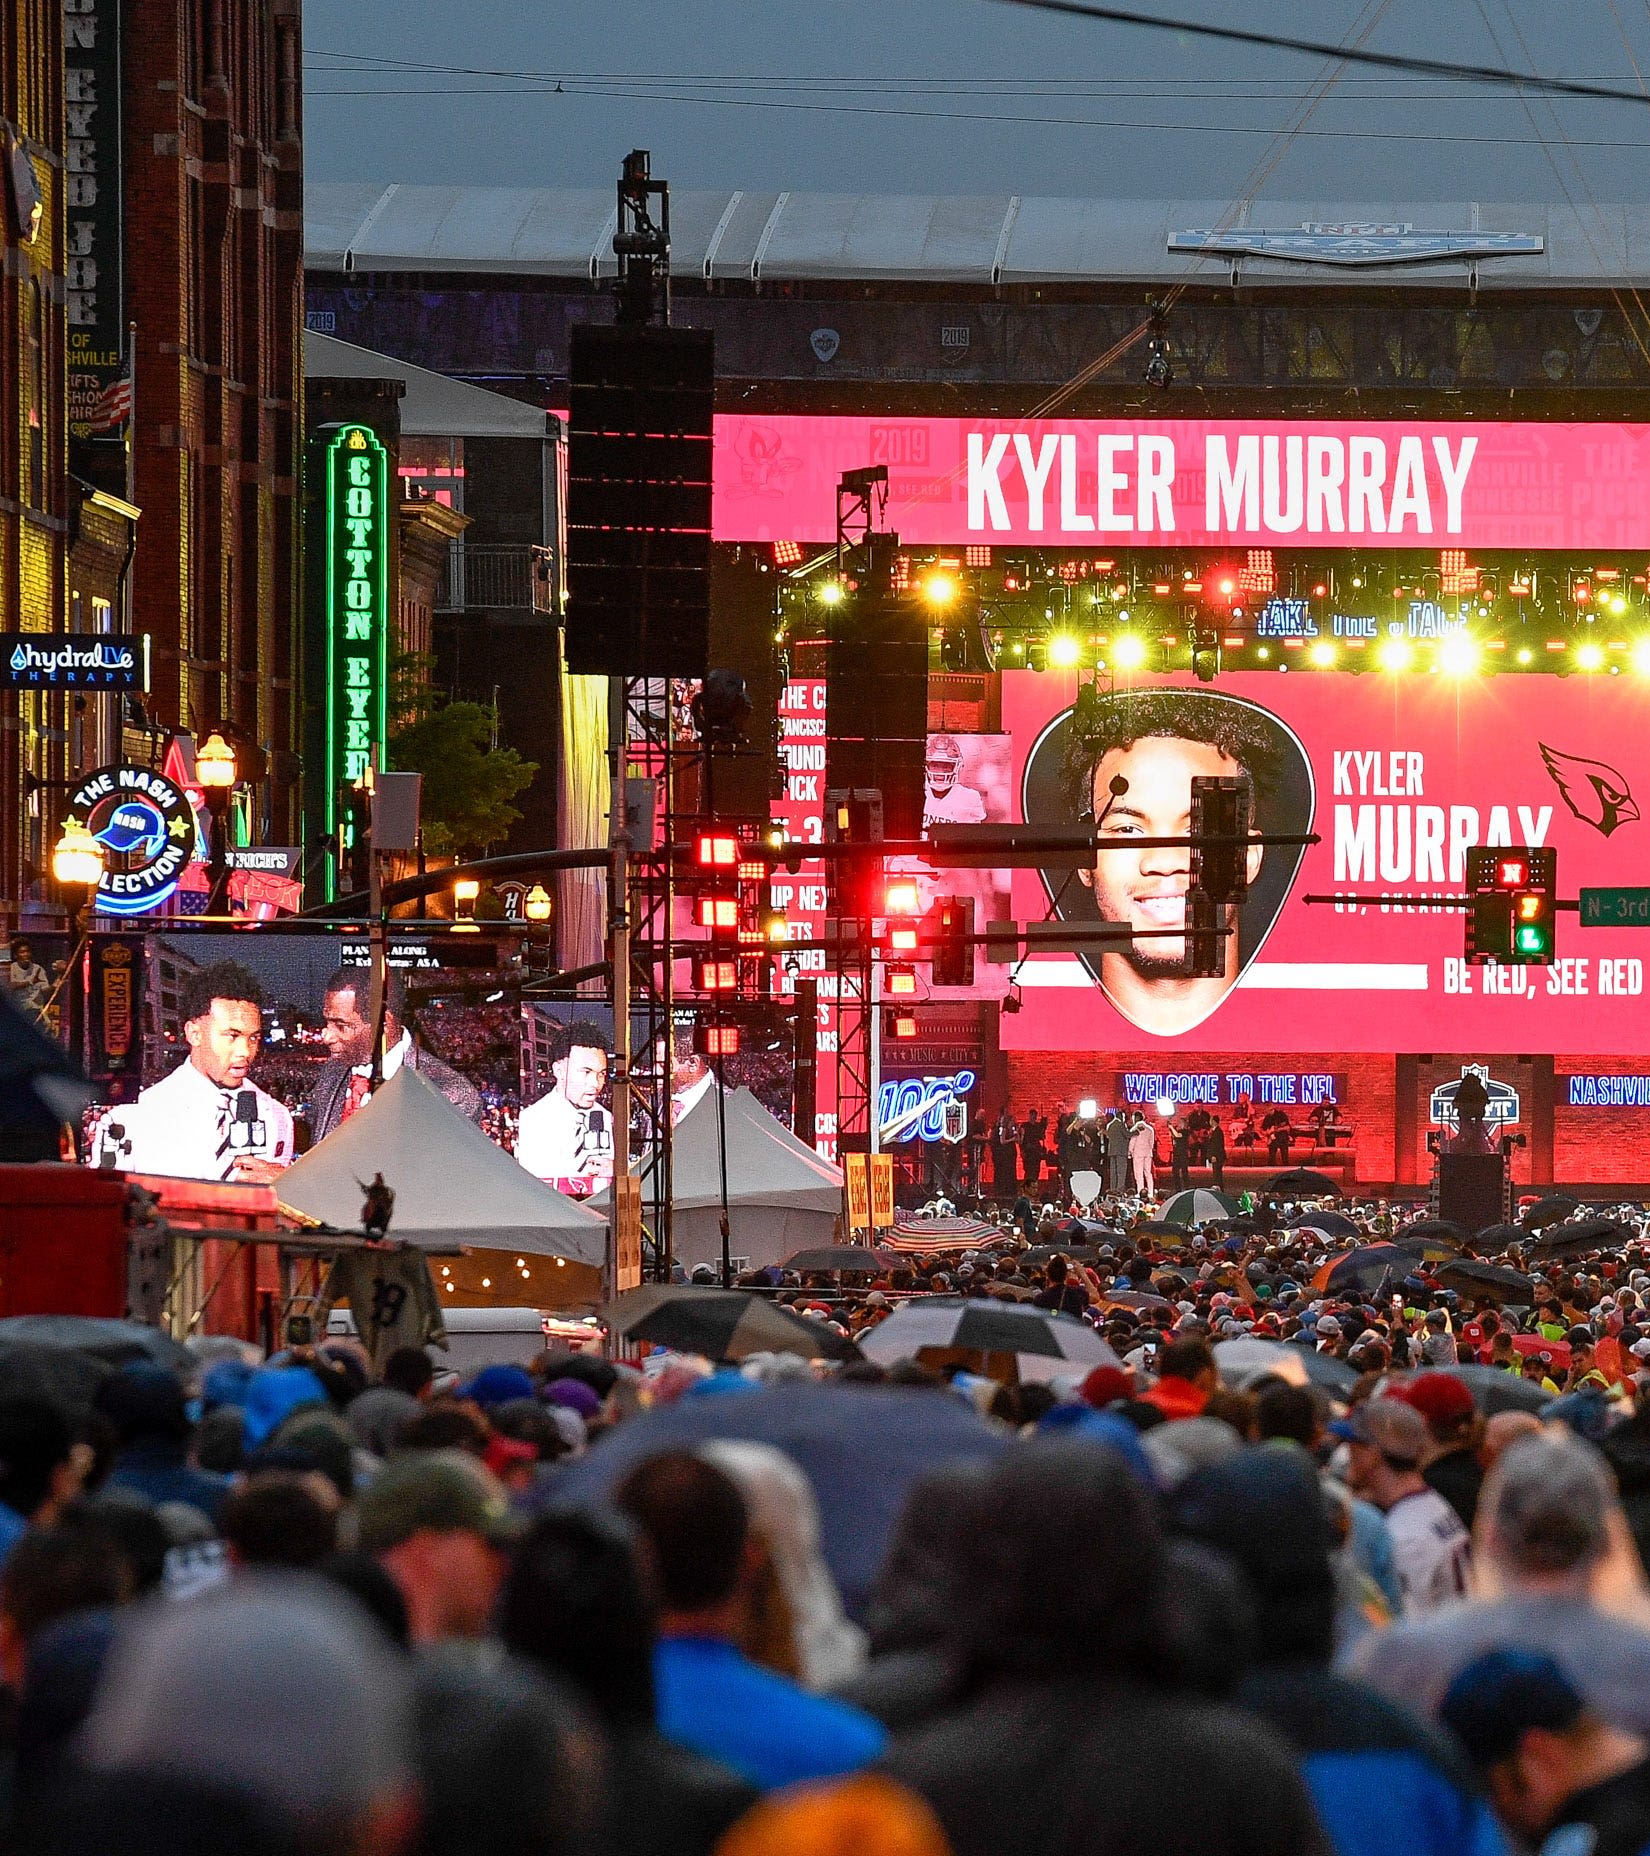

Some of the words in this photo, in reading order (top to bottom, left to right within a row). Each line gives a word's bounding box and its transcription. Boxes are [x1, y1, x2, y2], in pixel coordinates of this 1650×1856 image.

[72, 333, 91, 348] OF
[943, 328, 968, 345] 2019
[872, 428, 927, 463] 2019
[967, 433, 1176, 532] KYLER
[1205, 434, 1479, 534] MURRAY
[344, 456, 373, 640] COTTON
[10, 671, 134, 682] THERAPY
[344, 657, 372, 780] EYED
[777, 745, 825, 771] OUND
[1333, 751, 1424, 796] KYLER
[74, 773, 115, 809] THE
[119, 769, 177, 809] NASH
[788, 775, 817, 801] ICK
[1333, 804, 1553, 882] MURRAY
[771, 885, 794, 911] UP
[783, 922, 813, 941] ETS
[1443, 957, 1471, 994] BE
[1483, 962, 1536, 999] RED,
[1547, 957, 1590, 995] SEE
[1599, 957, 1643, 995] RED
[108, 971, 127, 1052] EXPERIENCE
[909, 1048, 937, 1062] MUSIC
[949, 1049, 969, 1062] CITY
[1124, 1074, 1219, 1104] WELCOME
[1226, 1074, 1253, 1104] TO
[1258, 1074, 1297, 1104] THE
[1301, 1075, 1337, 1104] NFL
